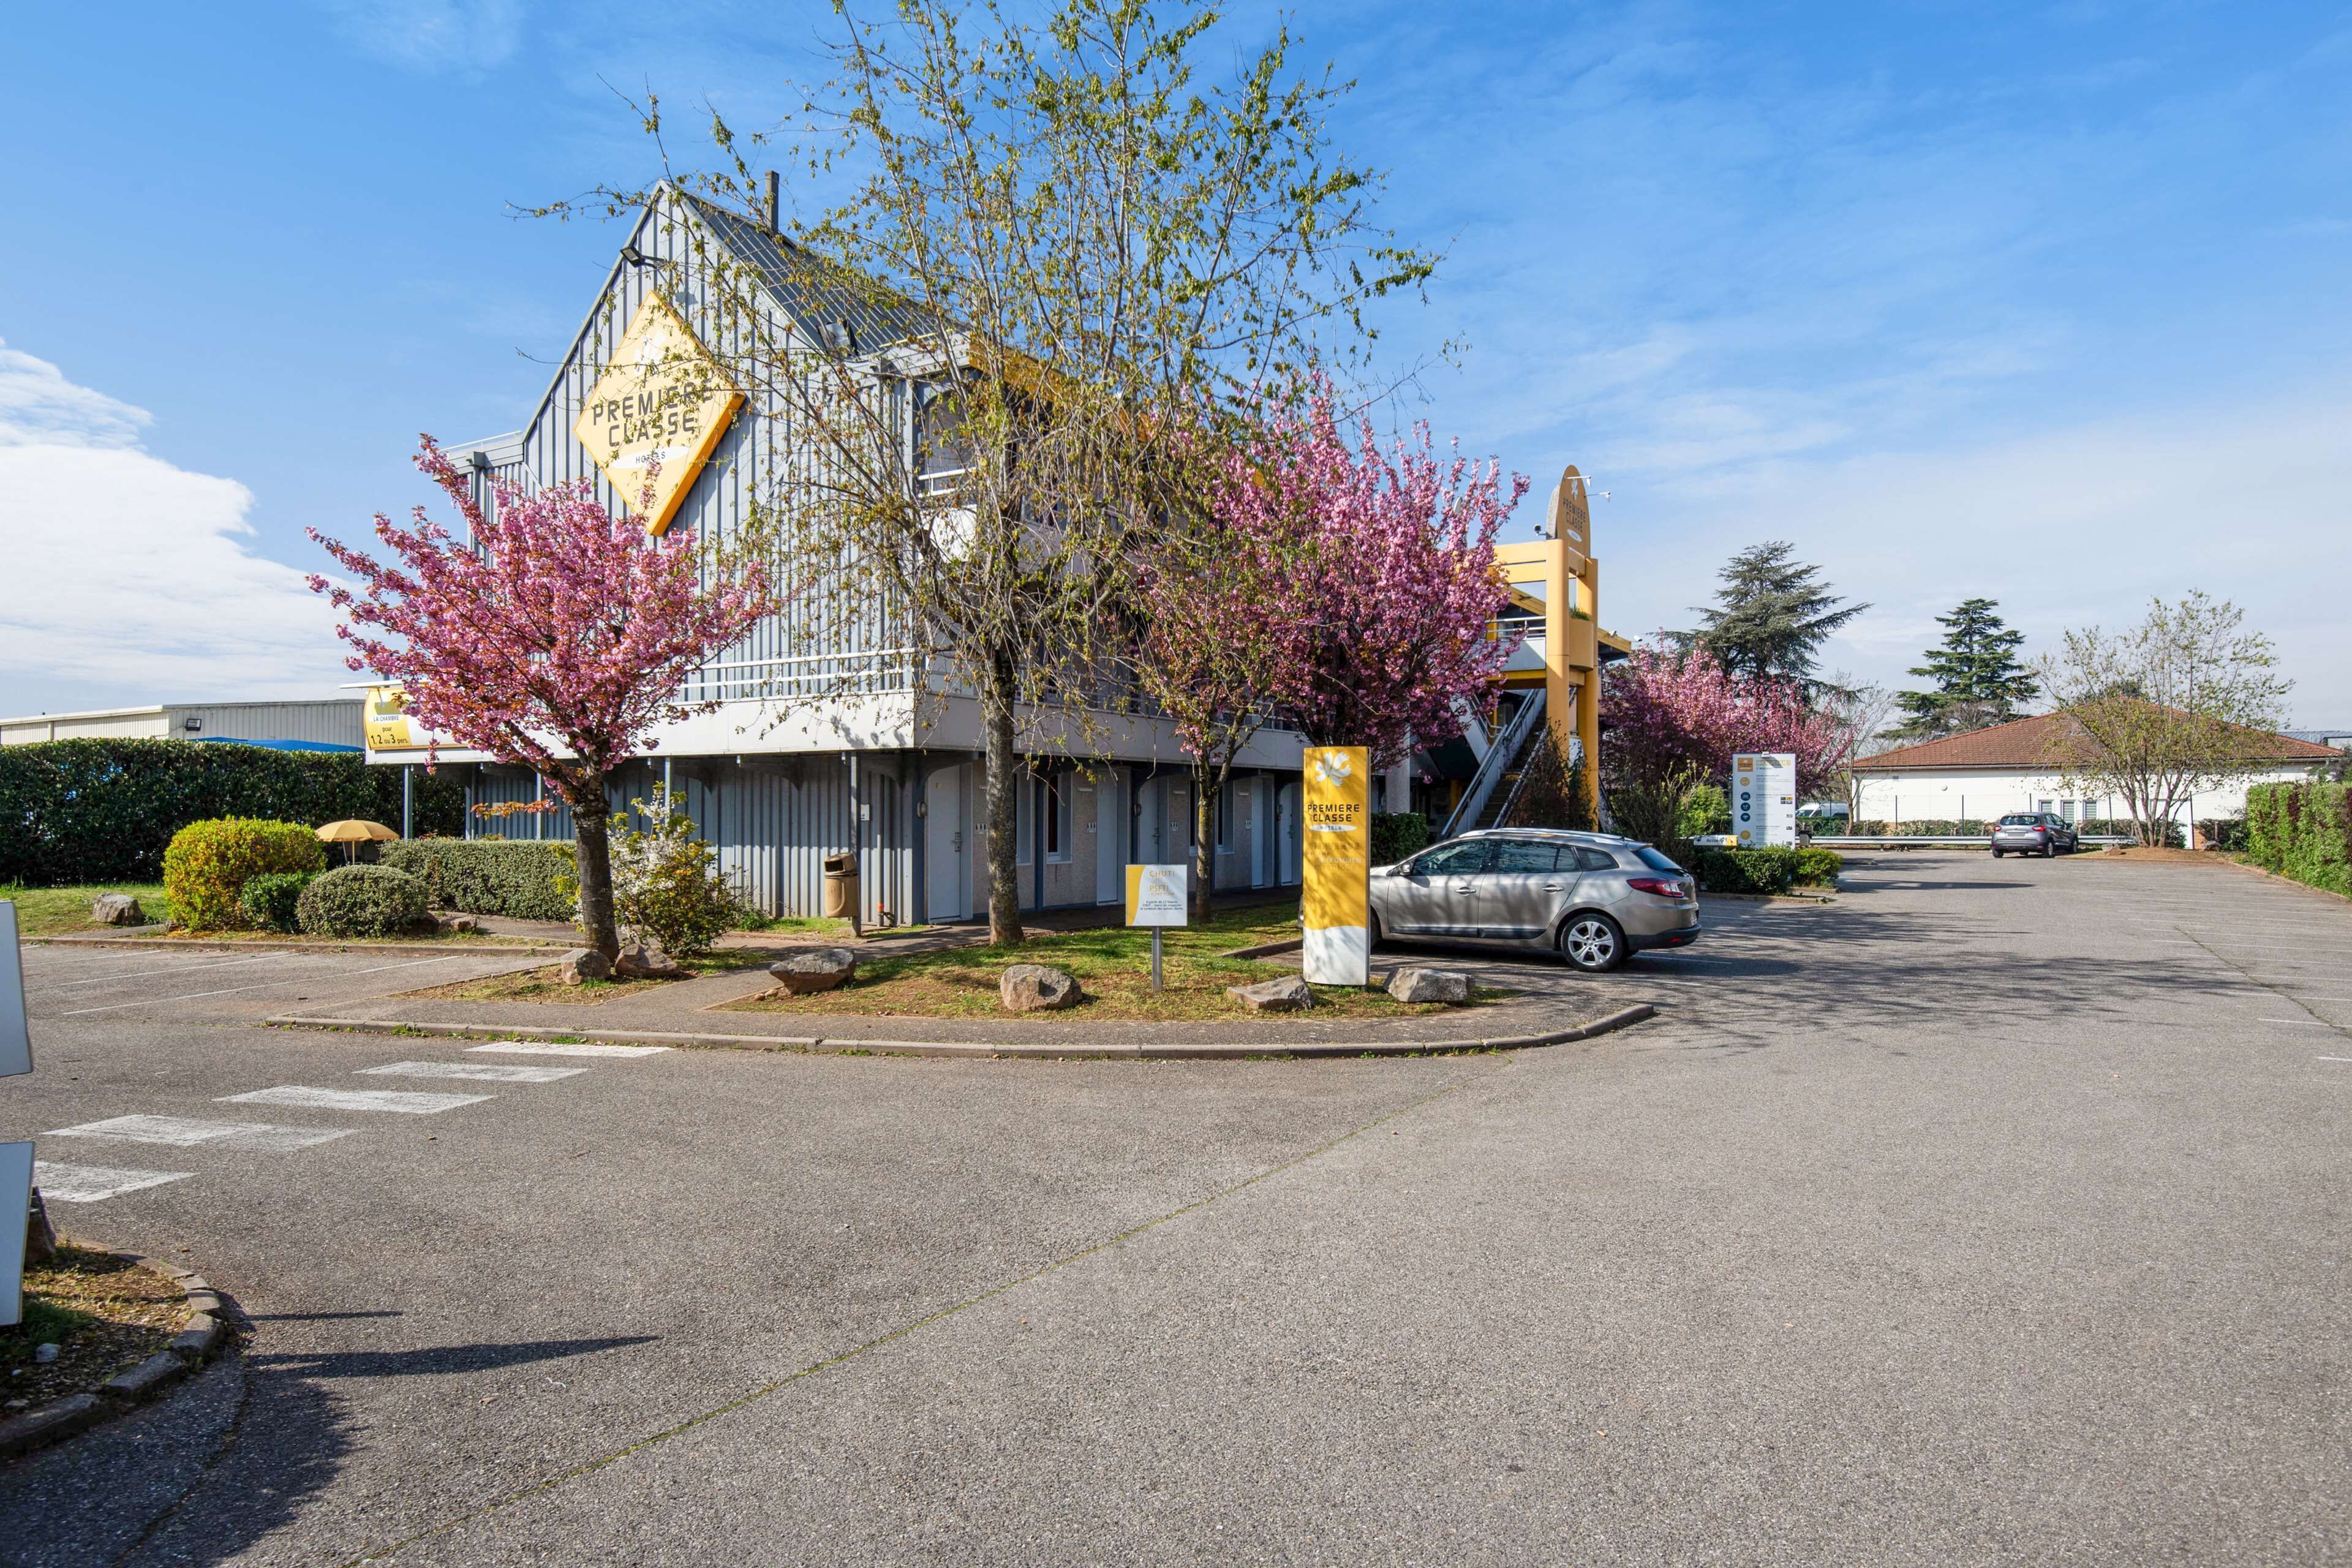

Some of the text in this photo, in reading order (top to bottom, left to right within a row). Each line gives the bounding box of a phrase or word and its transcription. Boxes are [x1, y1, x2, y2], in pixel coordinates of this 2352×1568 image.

[593, 378, 712, 426] PREMIERE
[609, 410, 695, 447] CLASSE
[635, 451, 666, 464] HOTELS
[1562, 496, 1586, 522] PREMIERE
[1566, 511, 1583, 532] CLASSE
[377, 734, 383, 745] 2
[390, 734, 396, 744] 3
[1308, 804, 1360, 812] PREMIERE
[1313, 813, 1352, 822] CLASSE
